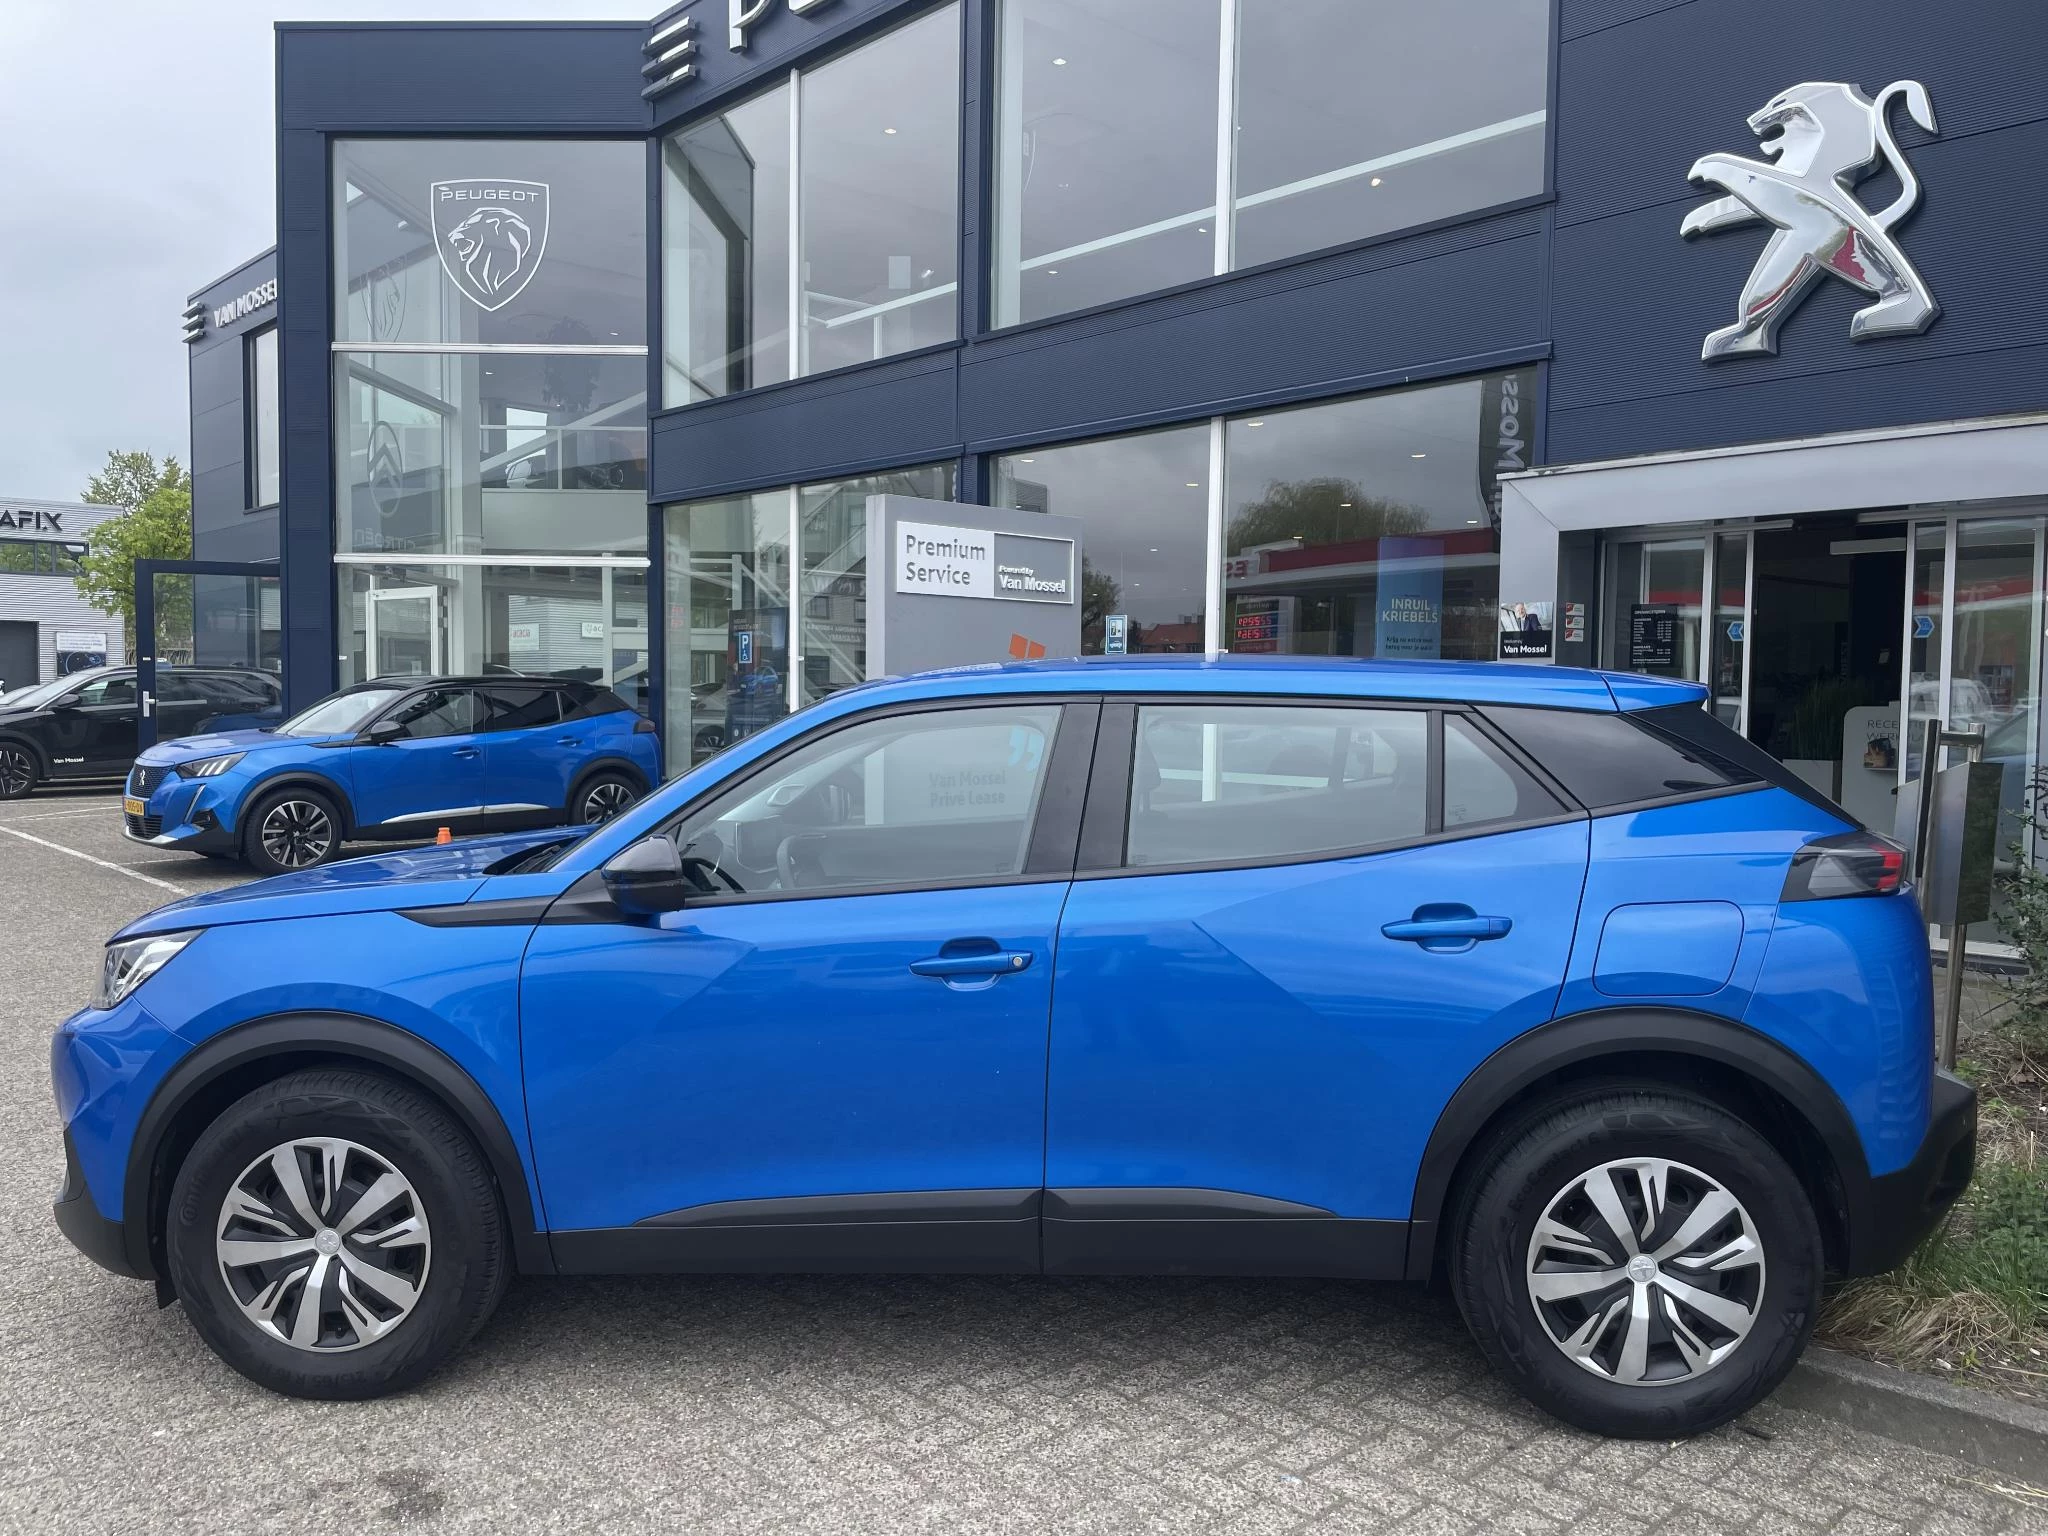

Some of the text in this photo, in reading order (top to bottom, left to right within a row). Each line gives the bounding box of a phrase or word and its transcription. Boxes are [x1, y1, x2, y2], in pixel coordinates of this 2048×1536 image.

[441, 189, 540, 203] PEUGEOT
[214, 301, 237, 328] VAN
[906, 534, 985, 561] Premium
[906, 561, 971, 585] Service
[1000, 574, 1066, 593] Van Mossel
[1391, 598, 1431, 611] INRUIL
[1382, 610, 1438, 623] KRIEBELS
[741, 635, 749, 649] P
[1504, 644, 1547, 654] Van Mossel
[928, 769, 1007, 788] Van Mossel
[968, 790, 1007, 805] Lease
